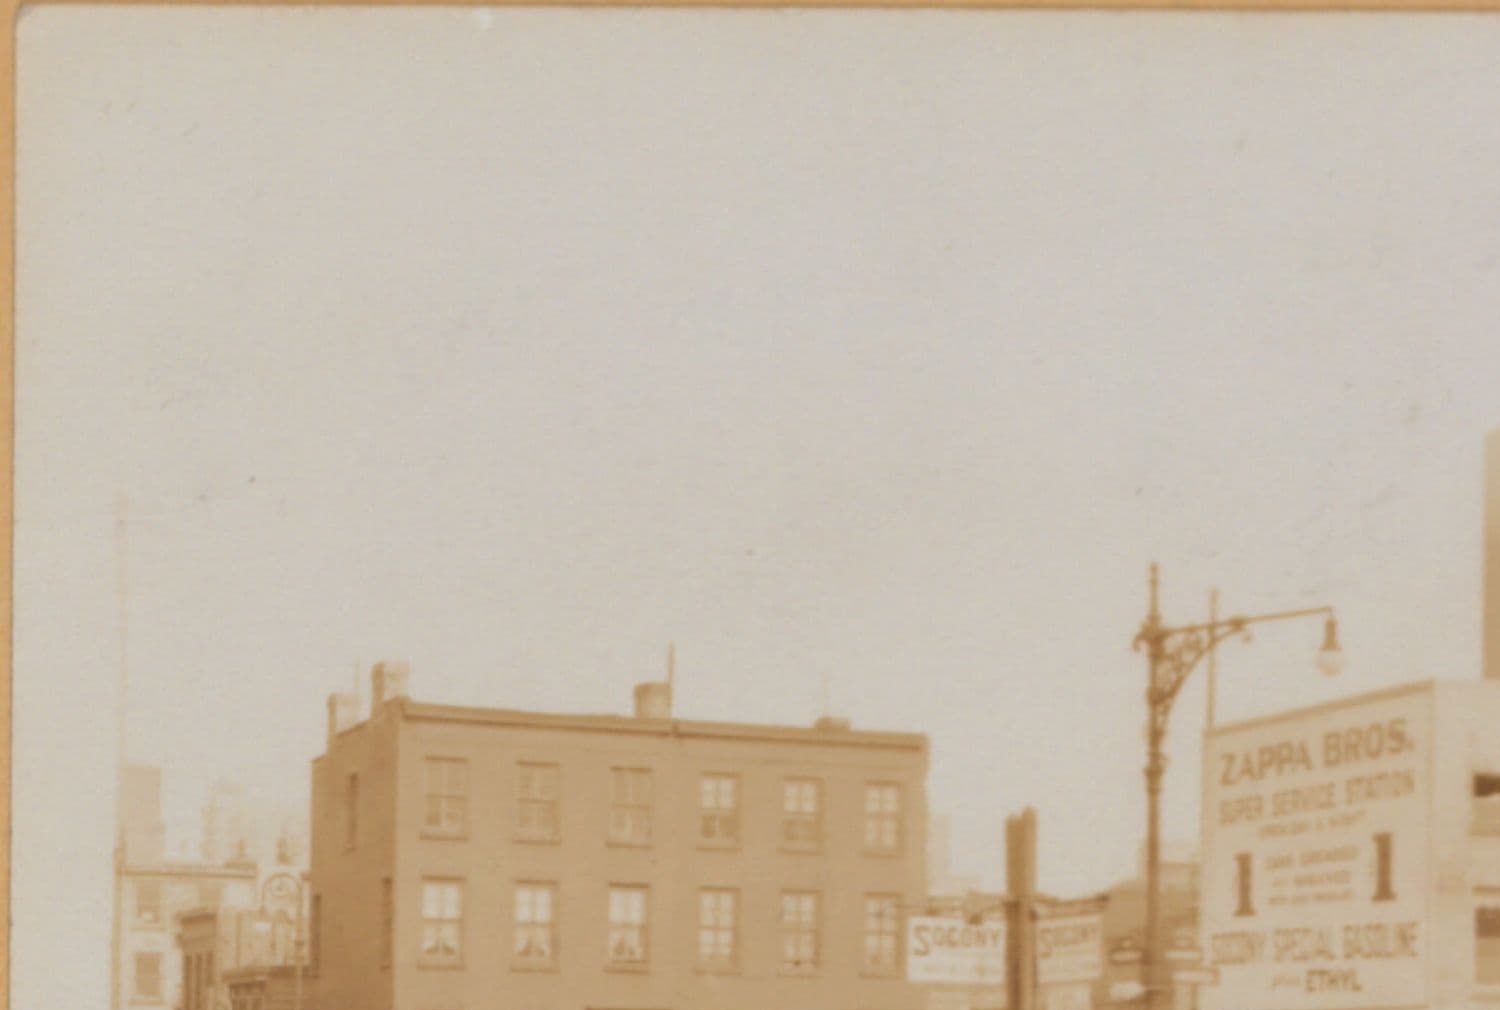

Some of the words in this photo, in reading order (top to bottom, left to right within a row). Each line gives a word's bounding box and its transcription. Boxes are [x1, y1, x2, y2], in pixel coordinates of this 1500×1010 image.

[1219, 740, 1313, 787] ZAPPA
[1322, 718, 1415, 768] BROS.
[1271, 782, 1336, 817] SERVICE
[1345, 769, 1415, 805] STATION
[913, 924, 1002, 957] SOCONY
[1210, 931, 1265, 966] SOCONY
[1273, 926, 1337, 963] SPECIAL
[1342, 921, 1419, 960] GASOLINE
[1305, 968, 1363, 993] ETHYL
